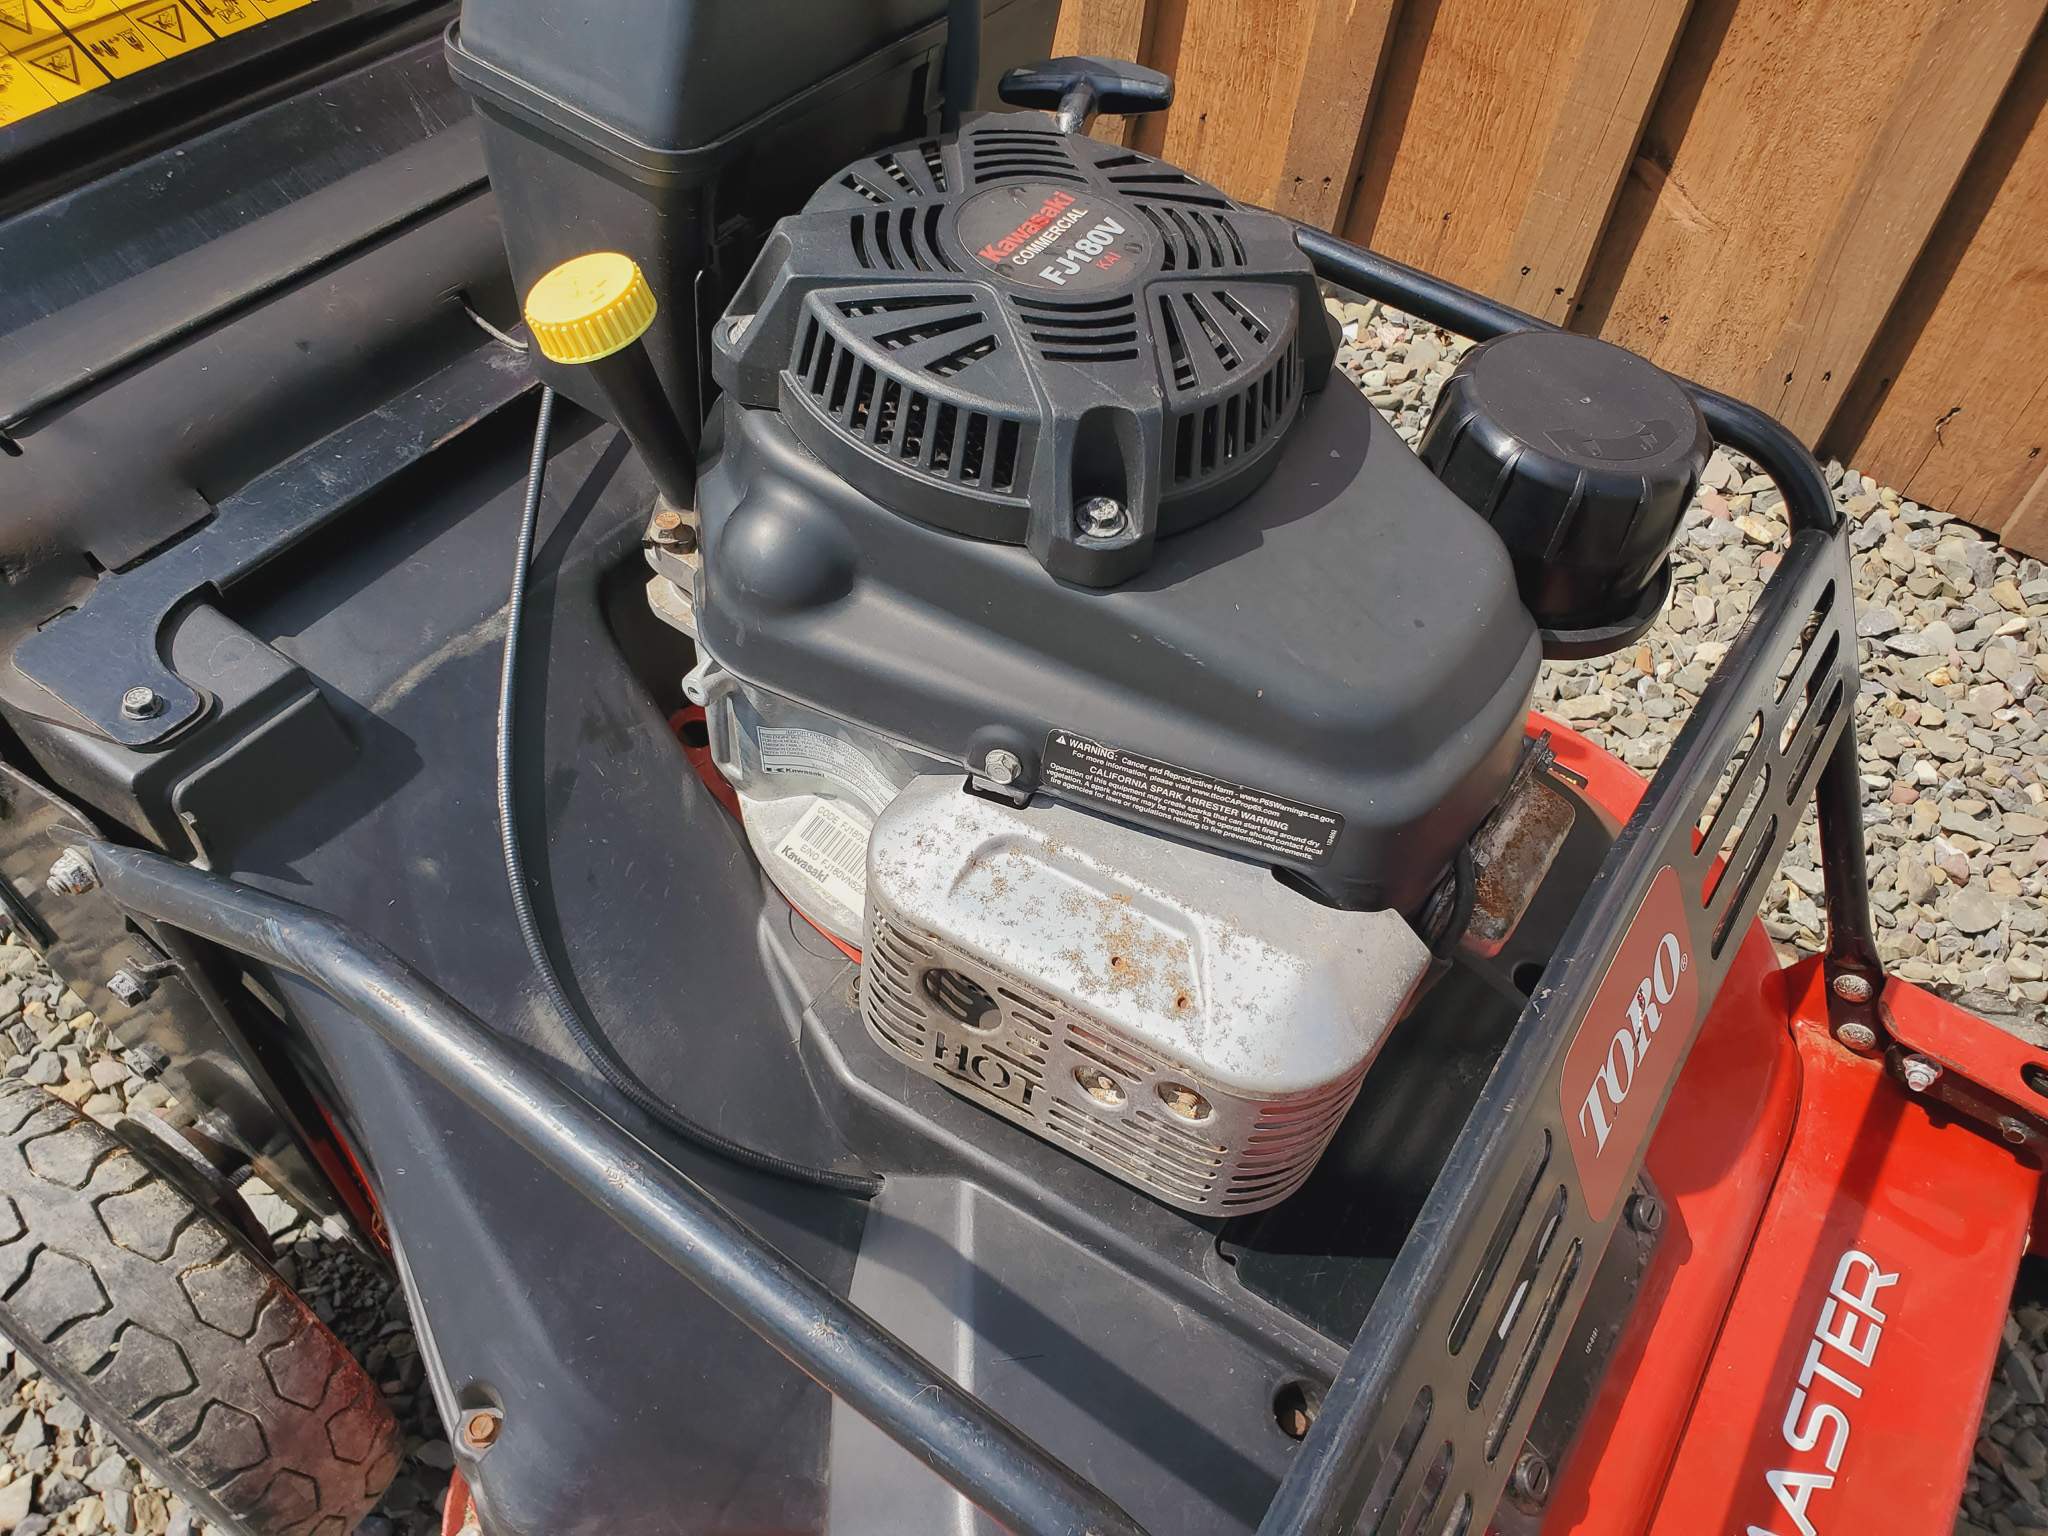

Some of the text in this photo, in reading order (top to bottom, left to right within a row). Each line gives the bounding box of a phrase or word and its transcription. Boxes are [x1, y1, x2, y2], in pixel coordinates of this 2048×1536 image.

[979, 190, 1076, 263] Kawasaki
[1012, 207, 1089, 266] COMMERCIAL
[1039, 216, 1126, 286] FJ180V
[1096, 251, 1122, 270] KAI
[785, 767, 825, 778] Kawasaki
[1069, 738, 1118, 761] WARNING:
[1121, 756, 1148, 770] Cancer
[1148, 766, 1164, 775] and
[1163, 769, 1213, 790] Reproductive
[1213, 784, 1234, 796] Harm
[1072, 749, 1085, 759] For
[1085, 755, 1105, 765] more
[1149, 775, 1174, 787] please
[1174, 782, 1191, 792] visit
[1089, 765, 1289, 831] CALIFORNIA SPARK ARRESTER WARNING
[816, 804, 840, 825] CODE
[1046, 769, 1323, 855] vegetation. A spark arrester may be required. The operator should contact local
[1050, 762, 1084, 779] Operation
[1093, 776, 1107, 786] this
[1107, 781, 1146, 798] equipment
[1146, 793, 1163, 804] may
[1163, 798, 1187, 810] create
[1187, 805, 1212, 818] sparks
[1212, 812, 1228, 822] that
[1228, 818, 1243, 826] can
[1243, 822, 1261, 832] start
[1261, 826, 1279, 836] fires
[1278, 832, 1307, 844] around
[1306, 839, 1321, 849] dry
[1050, 777, 1062, 785] fire
[1062, 781, 1094, 796] agencies
[1094, 791, 1105, 799] for
[1105, 794, 1122, 805] laws
[1132, 803, 1172, 820] regulations
[1172, 816, 1201, 830] relating
[1201, 823, 1210, 831] to
[1210, 826, 1223, 835] fire
[1222, 830, 1263, 846] prevention
[1263, 842, 1313, 861] requirements.
[780, 843, 830, 885] Kawasaki
[799, 843, 869, 898] E/NO FJ180VN520
[935, 1031, 1046, 1106] HOT
[1746, 1250, 1900, 1536] ASTER
